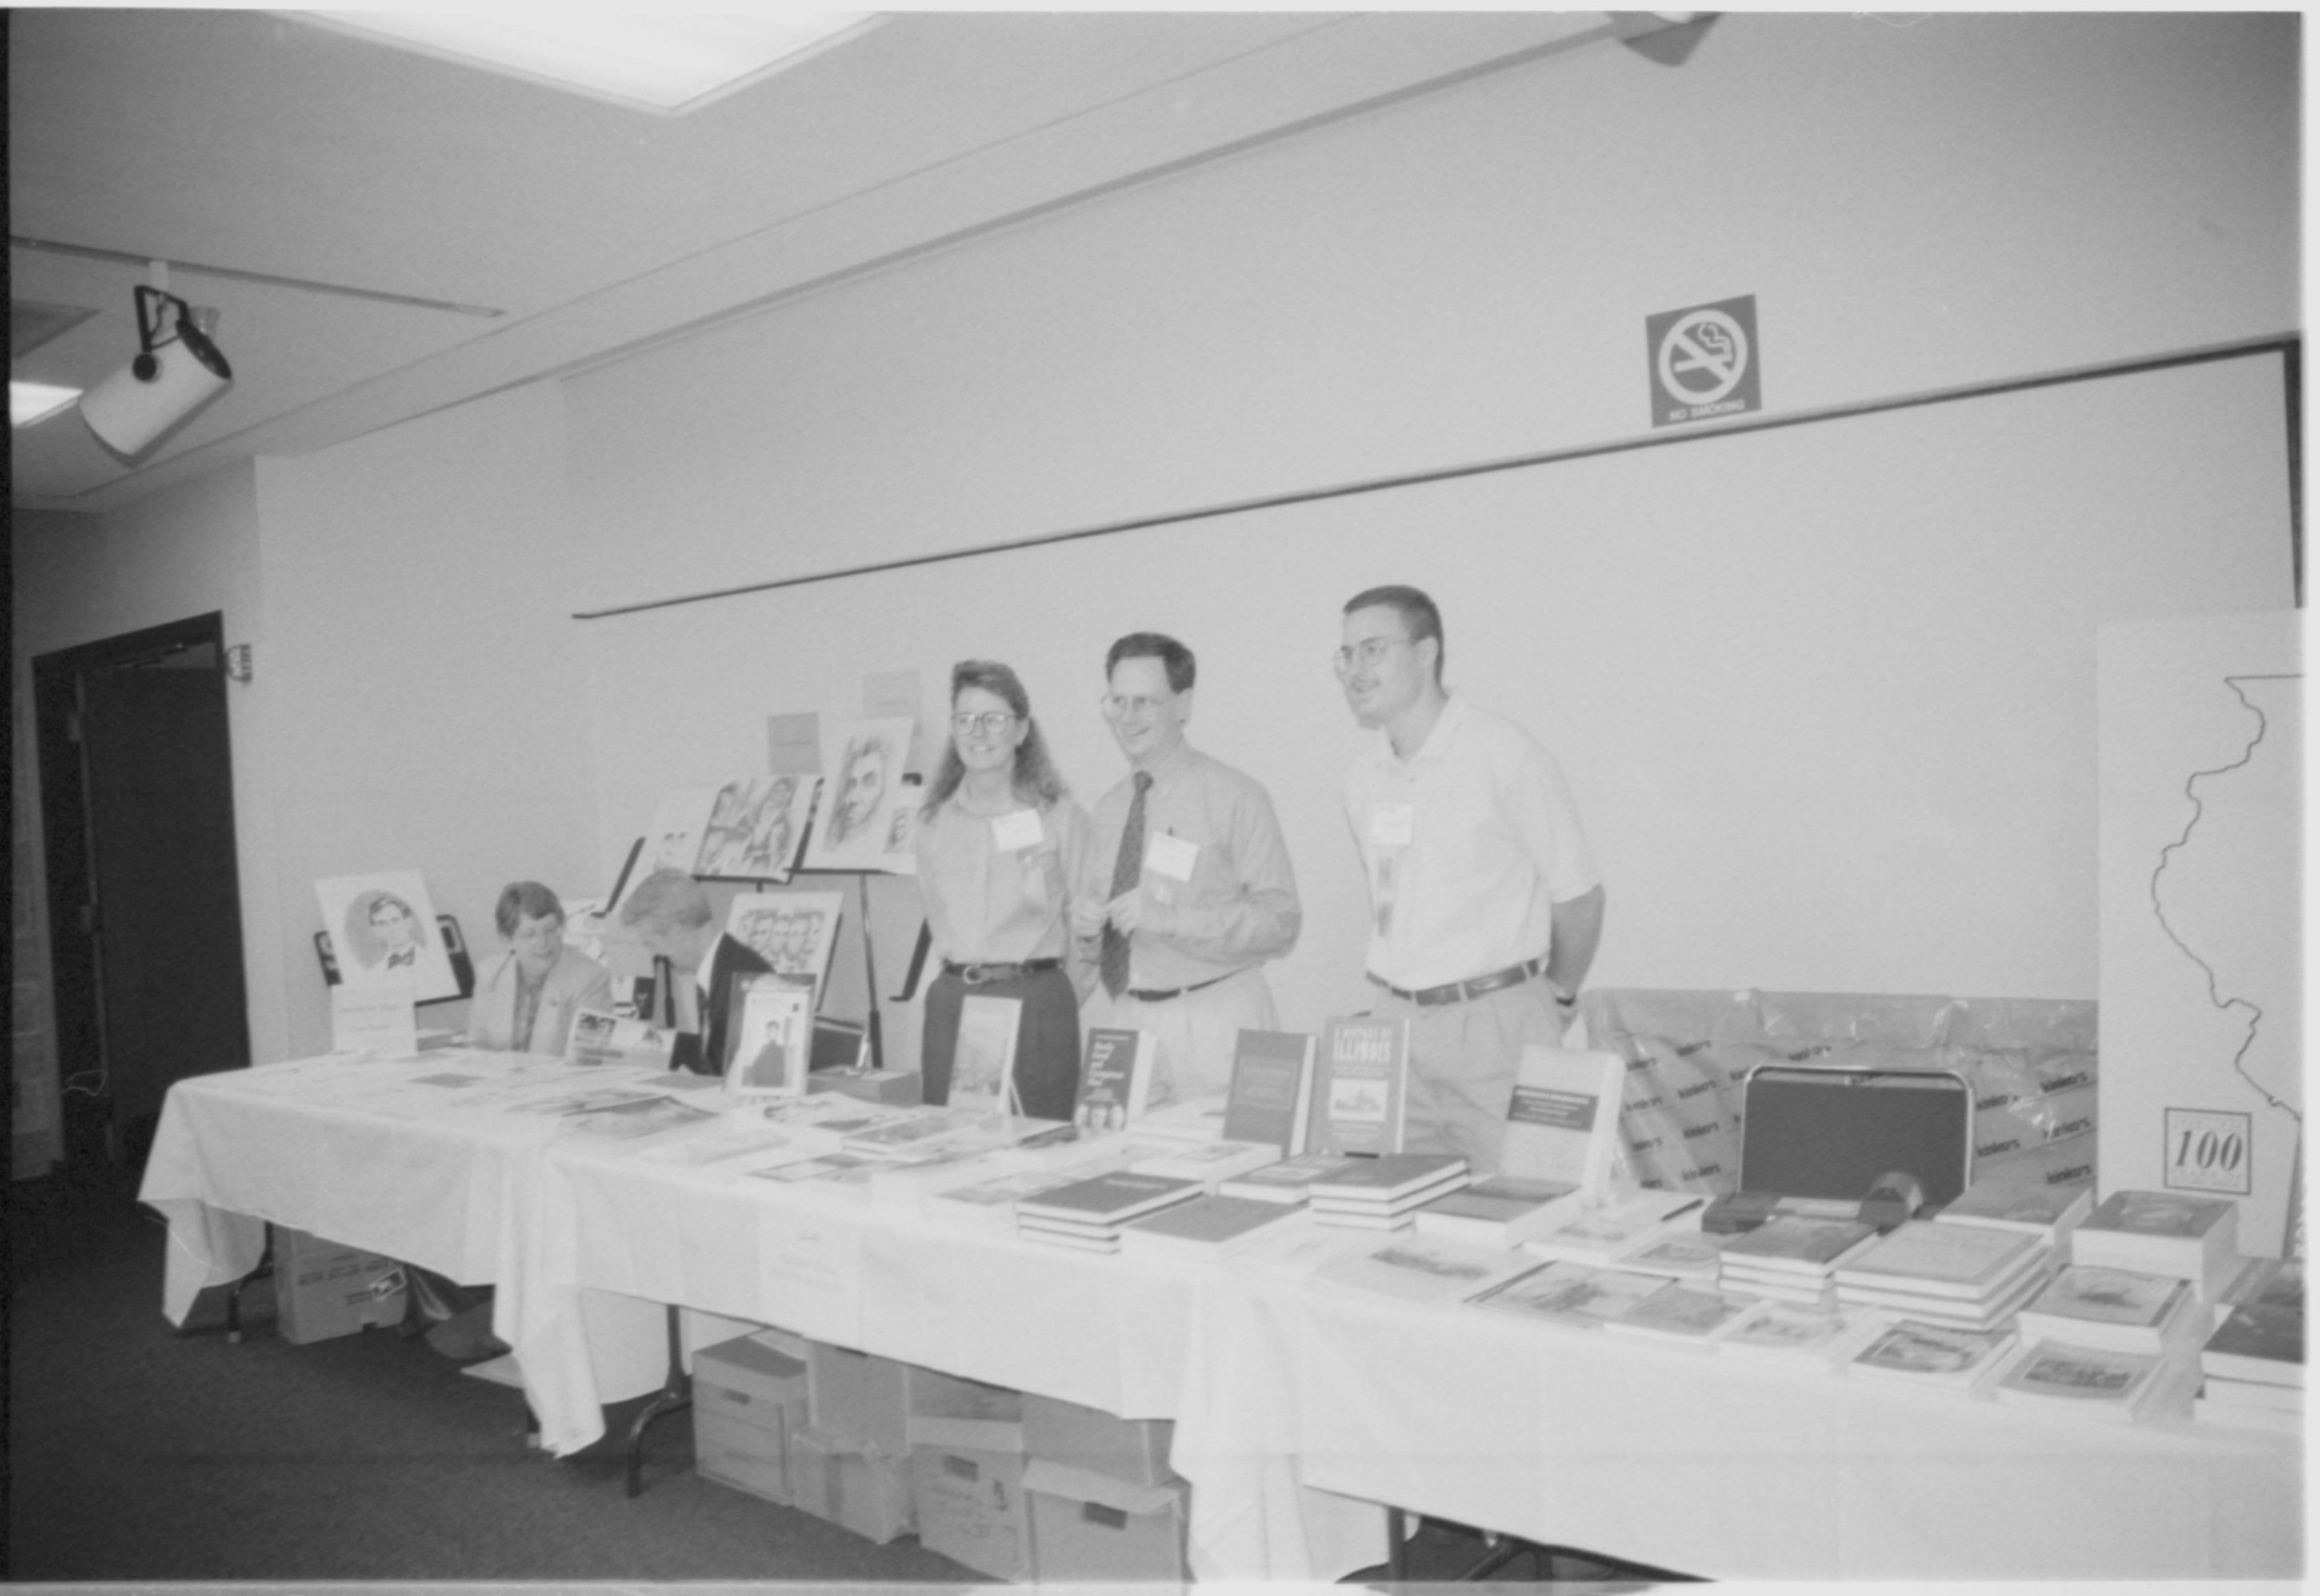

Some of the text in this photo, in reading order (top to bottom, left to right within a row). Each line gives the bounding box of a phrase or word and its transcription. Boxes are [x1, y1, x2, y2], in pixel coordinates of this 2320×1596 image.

[1669, 398, 1745, 422] NO SMOKING
[1333, 1039, 1392, 1063] ILLINOIS
[2175, 1129, 2243, 1172] 100
